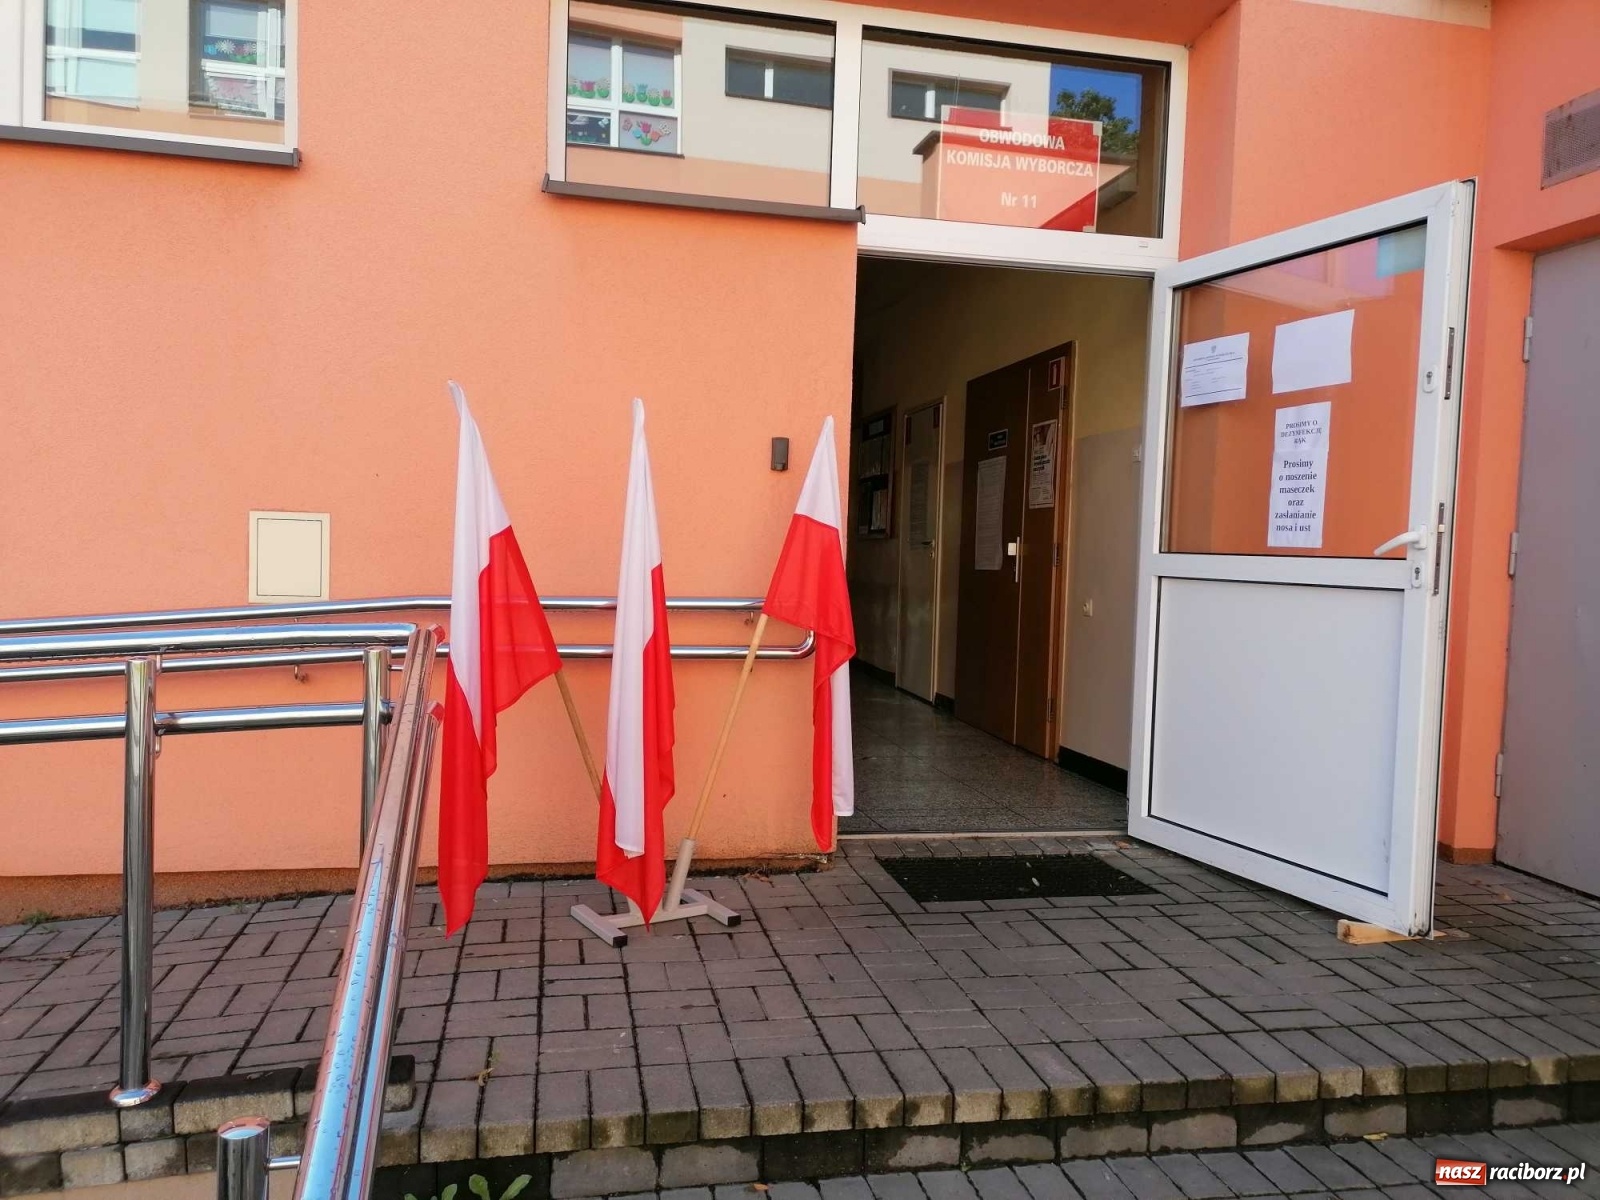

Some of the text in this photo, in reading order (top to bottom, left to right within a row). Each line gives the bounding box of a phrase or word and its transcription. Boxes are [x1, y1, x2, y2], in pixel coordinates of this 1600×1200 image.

[979, 128, 1065, 151] OBWODOWA
[946, 149, 1094, 177] KOMISJA WYBORCZA
[1001, 191, 1037, 209] Nr 11
[1285, 420, 1312, 429] PROSIMY
[1283, 458, 1314, 469] Prosimy
[1285, 471, 1318, 481] noszenie
[1279, 484, 1315, 494] maseczek
[1287, 499, 1305, 507] oraz
[1275, 524, 1293, 532] nosa
[1299, 524, 1311, 532] ust
